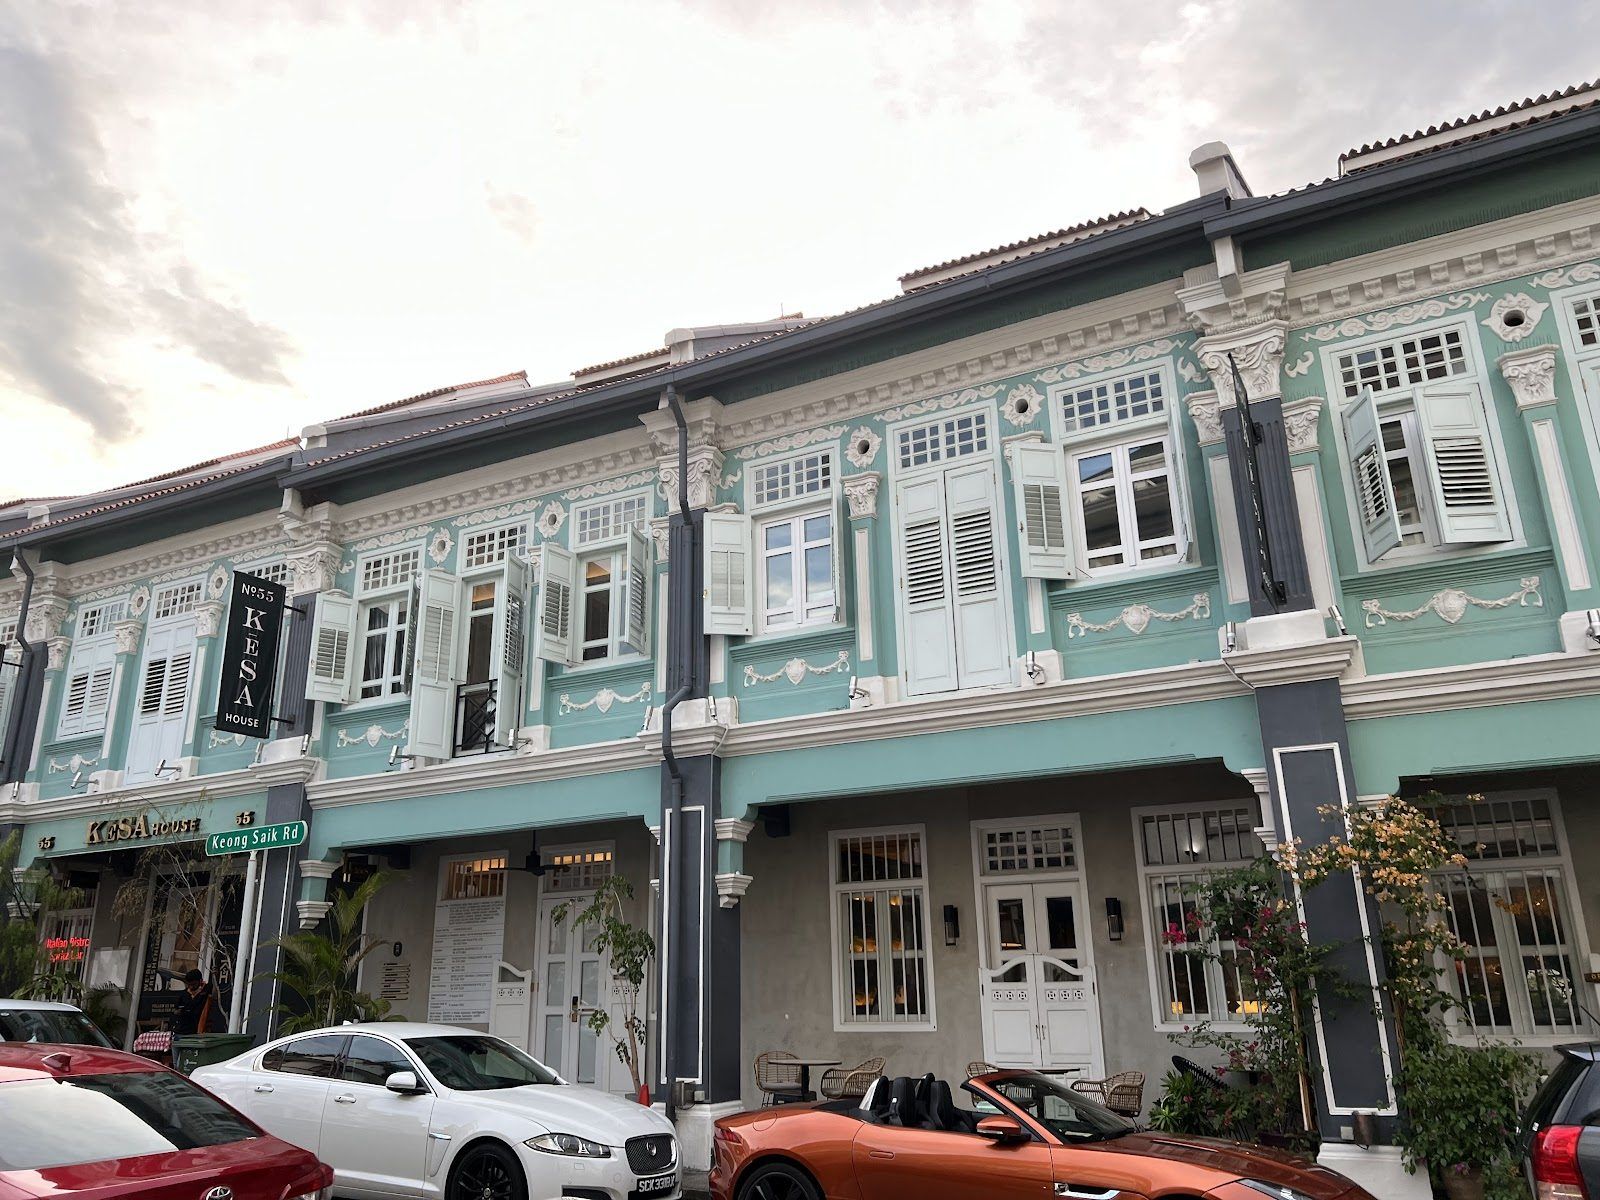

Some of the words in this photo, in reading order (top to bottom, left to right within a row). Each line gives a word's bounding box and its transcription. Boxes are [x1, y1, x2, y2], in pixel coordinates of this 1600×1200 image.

[225, 712, 260, 728] HOUSE
[235, 811, 255, 826] 55
[152, 818, 201, 836] HOUSE
[38, 837, 56, 849] 55
[212, 835, 248, 849] Keong
[252, 828, 278, 844] Saik
[283, 824, 299, 840] Rd
[46, 937, 68, 948] Italian
